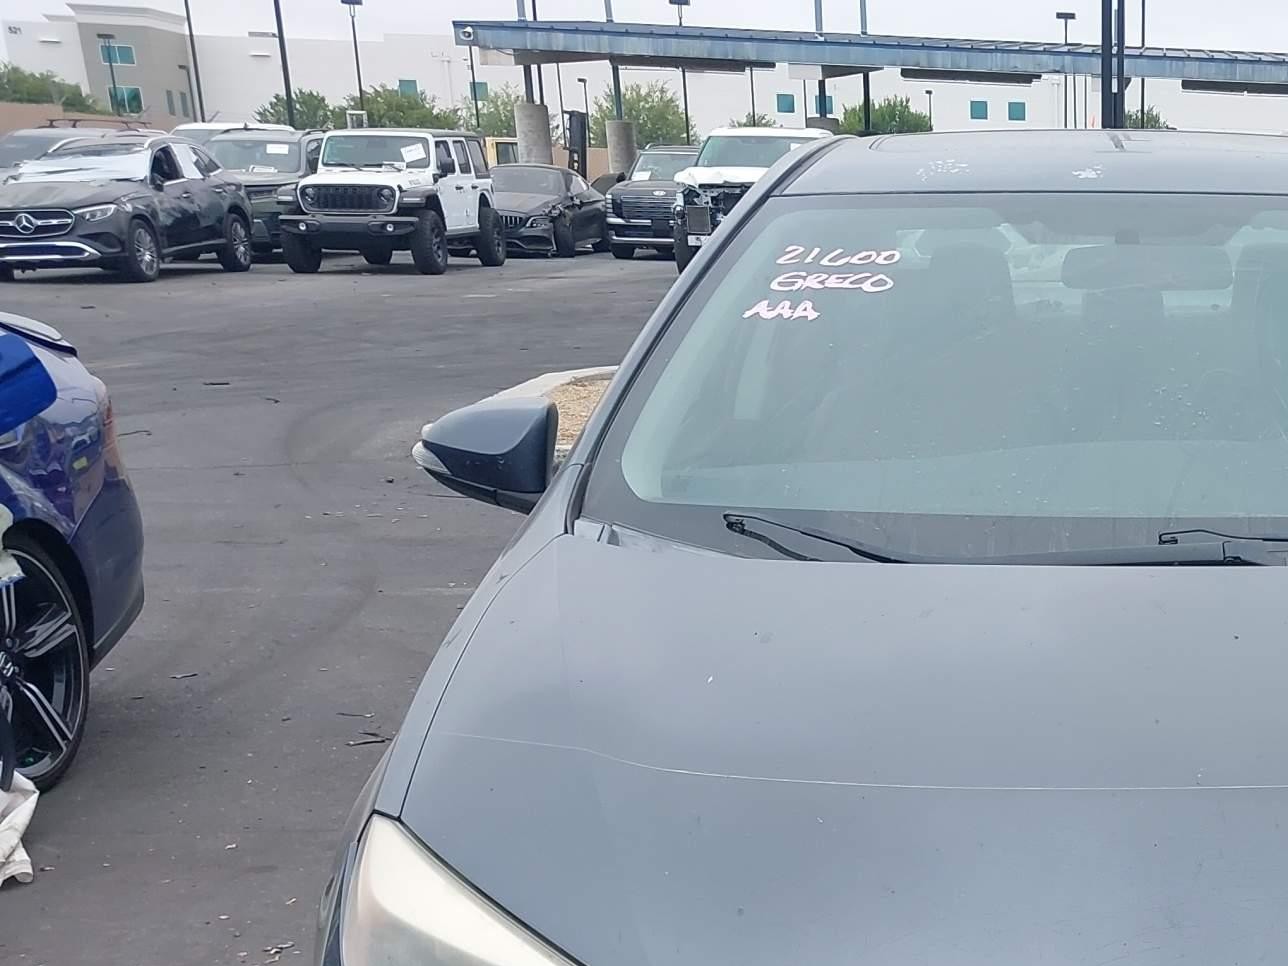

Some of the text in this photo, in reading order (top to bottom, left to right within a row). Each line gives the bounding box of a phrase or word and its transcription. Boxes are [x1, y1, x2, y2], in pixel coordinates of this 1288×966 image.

[775, 245, 901, 266] 21600
[769, 271, 894, 293] GRECO
[742, 300, 821, 321] AAA
